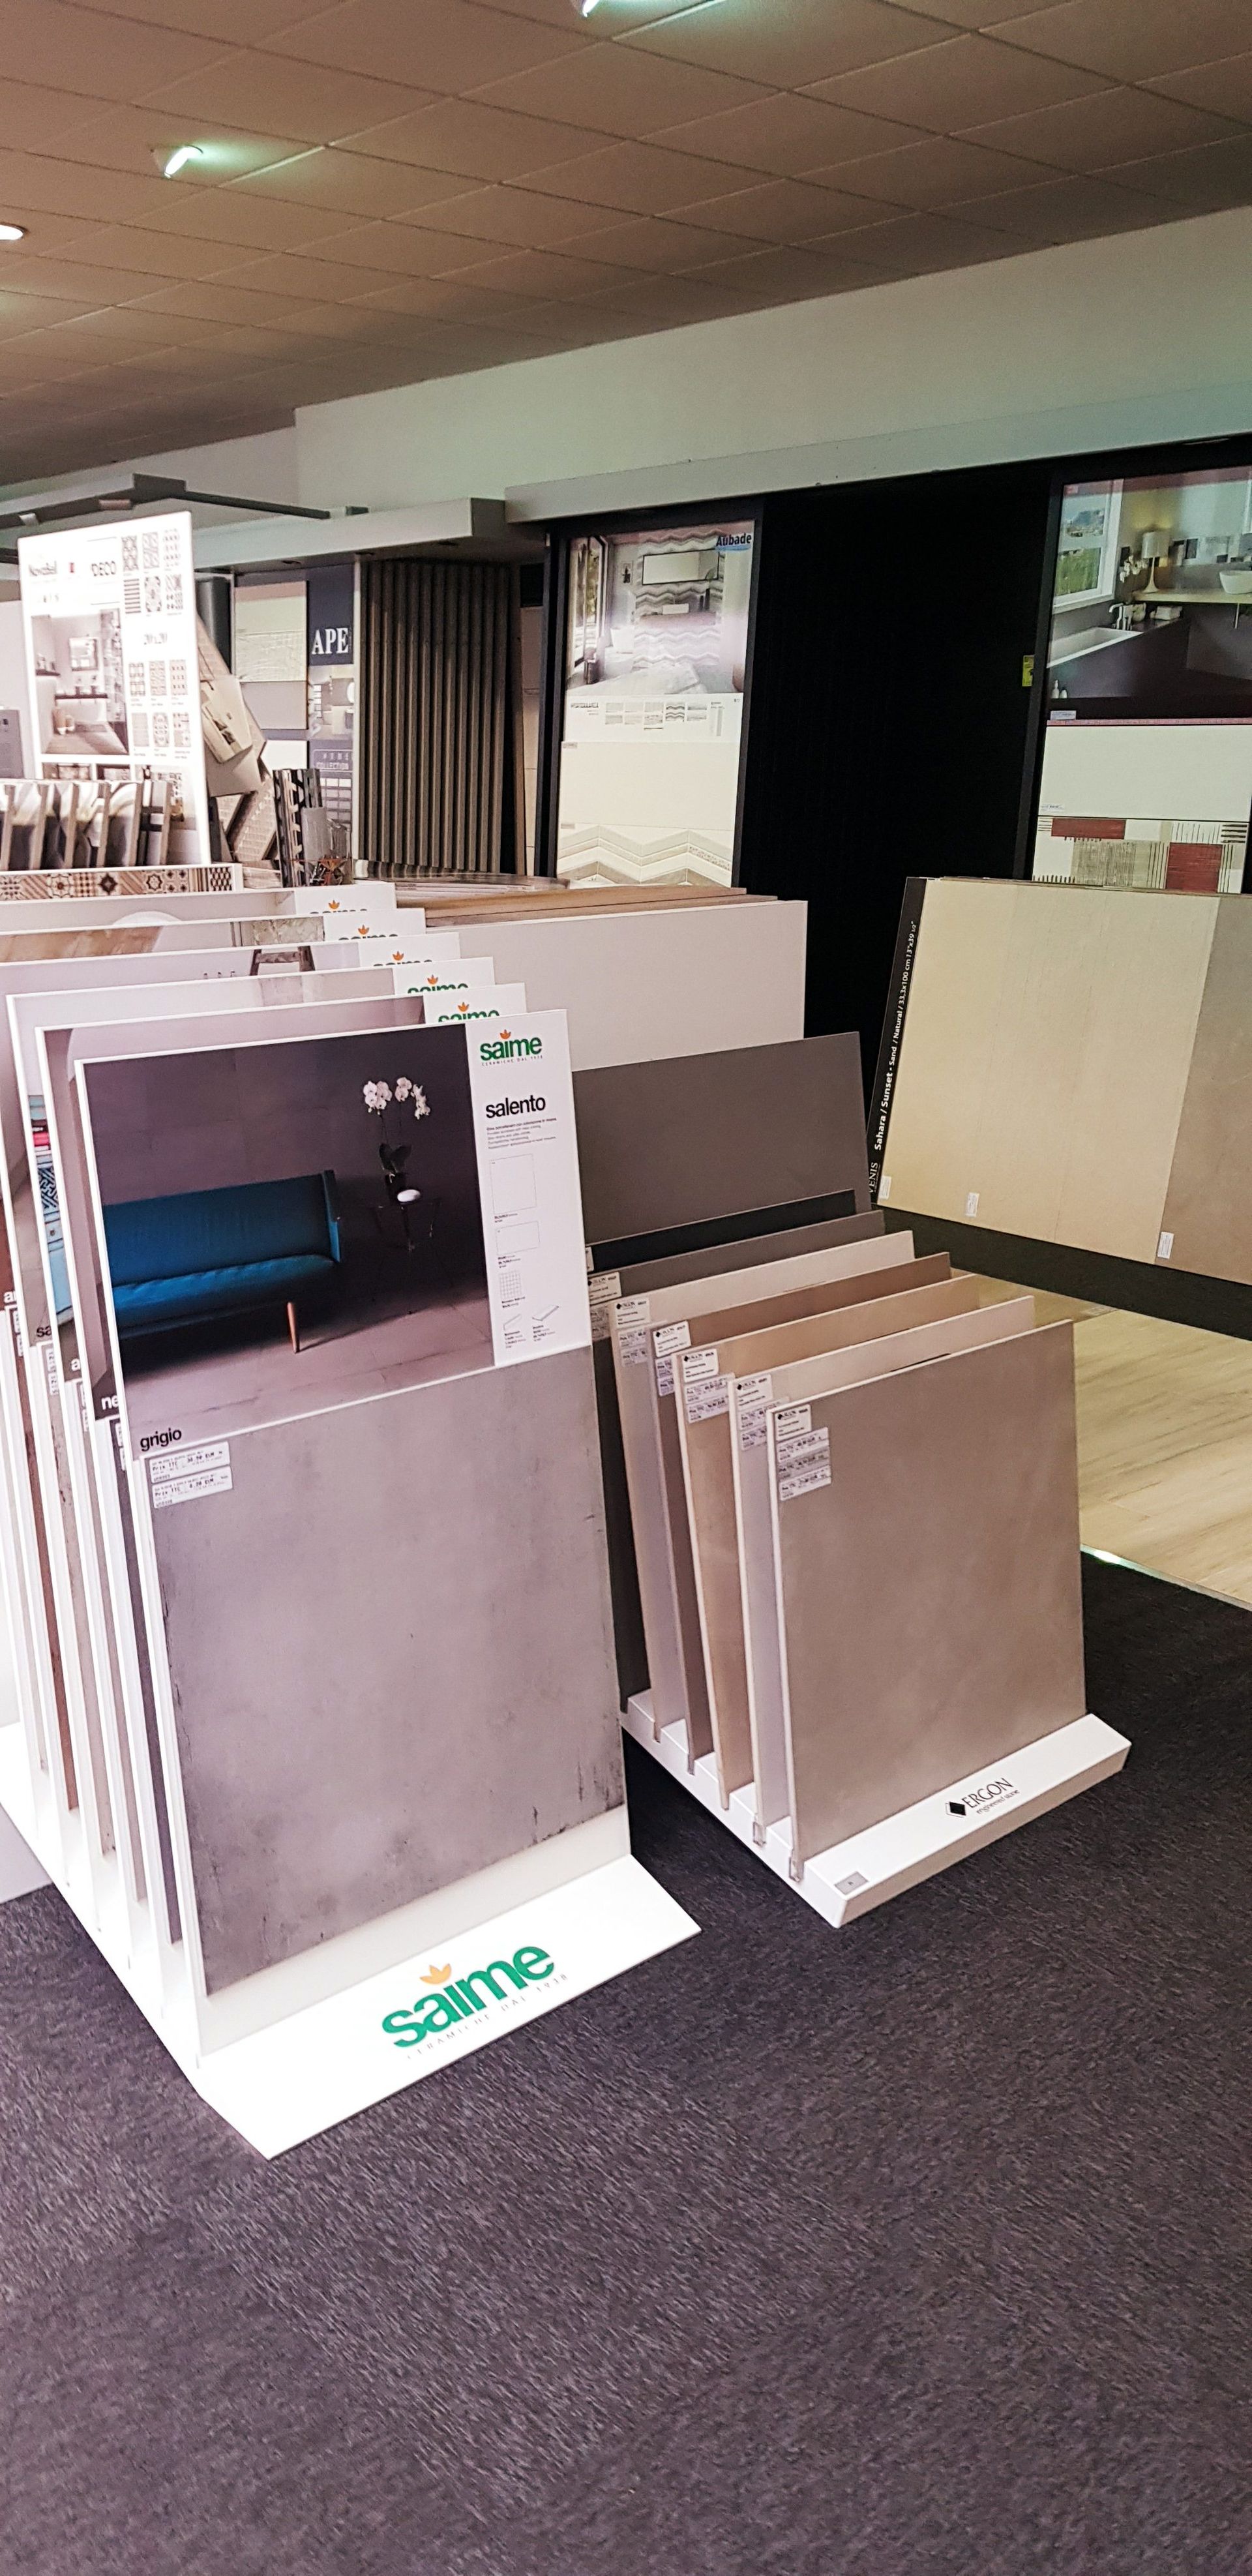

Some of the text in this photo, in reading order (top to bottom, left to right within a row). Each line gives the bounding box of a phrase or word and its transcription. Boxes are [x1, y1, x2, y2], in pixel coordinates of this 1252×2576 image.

[716, 532, 752, 547] Aubade
[311, 627, 349, 655] APE
[480, 1037, 543, 1061] saime
[874, 1115, 886, 1150] Sahara
[881, 1072, 893, 1108] Sunset
[889, 1046, 897, 1066] Sand
[893, 1011, 903, 1040] Natural
[905, 959, 911, 971] cm
[486, 1094, 546, 1118] salento
[140, 1428, 182, 1452] grigio
[961, 1778, 1013, 1808] ERGON
[382, 1946, 554, 2047] saime
